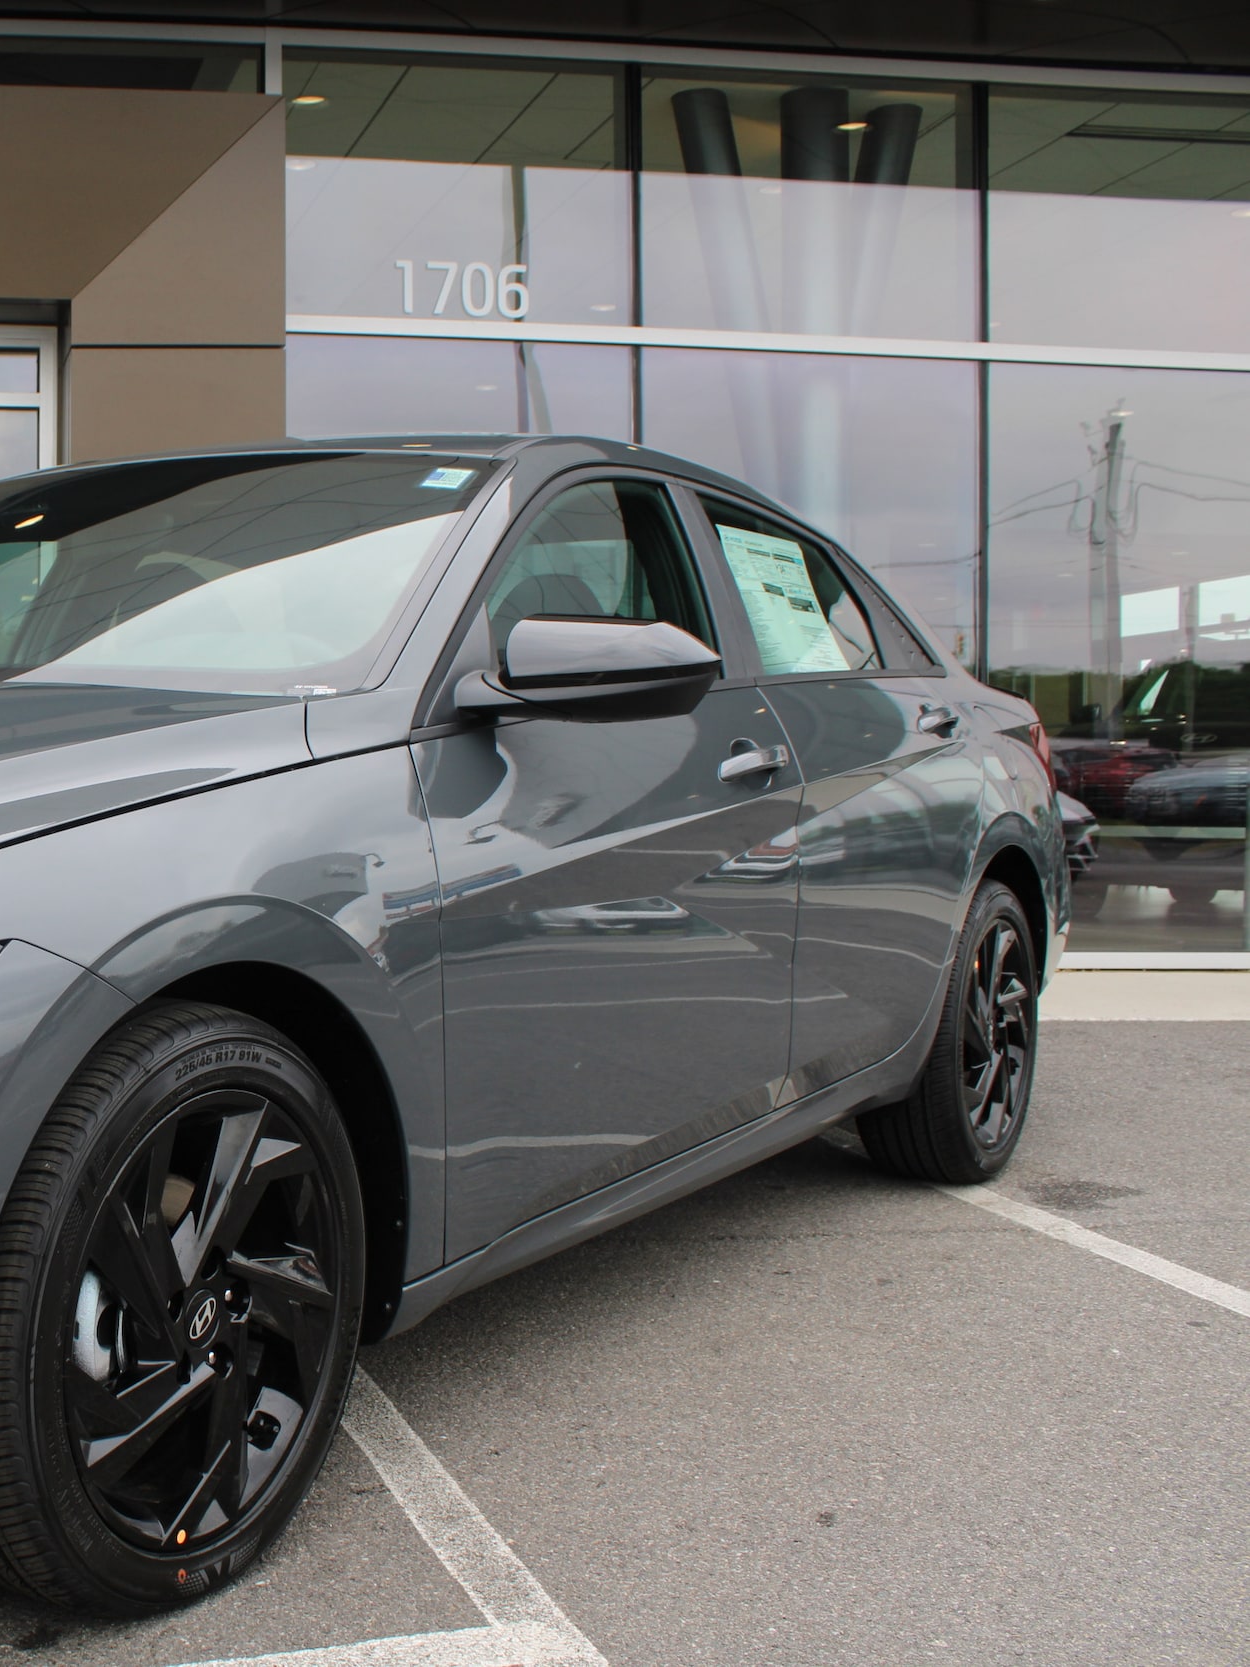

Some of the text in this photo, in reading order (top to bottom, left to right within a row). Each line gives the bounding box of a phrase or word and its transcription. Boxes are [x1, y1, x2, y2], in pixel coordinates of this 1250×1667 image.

[395, 259, 530, 319] 1706
[175, 1054, 213, 1081] 225/45
[214, 1050, 237, 1064] R17
